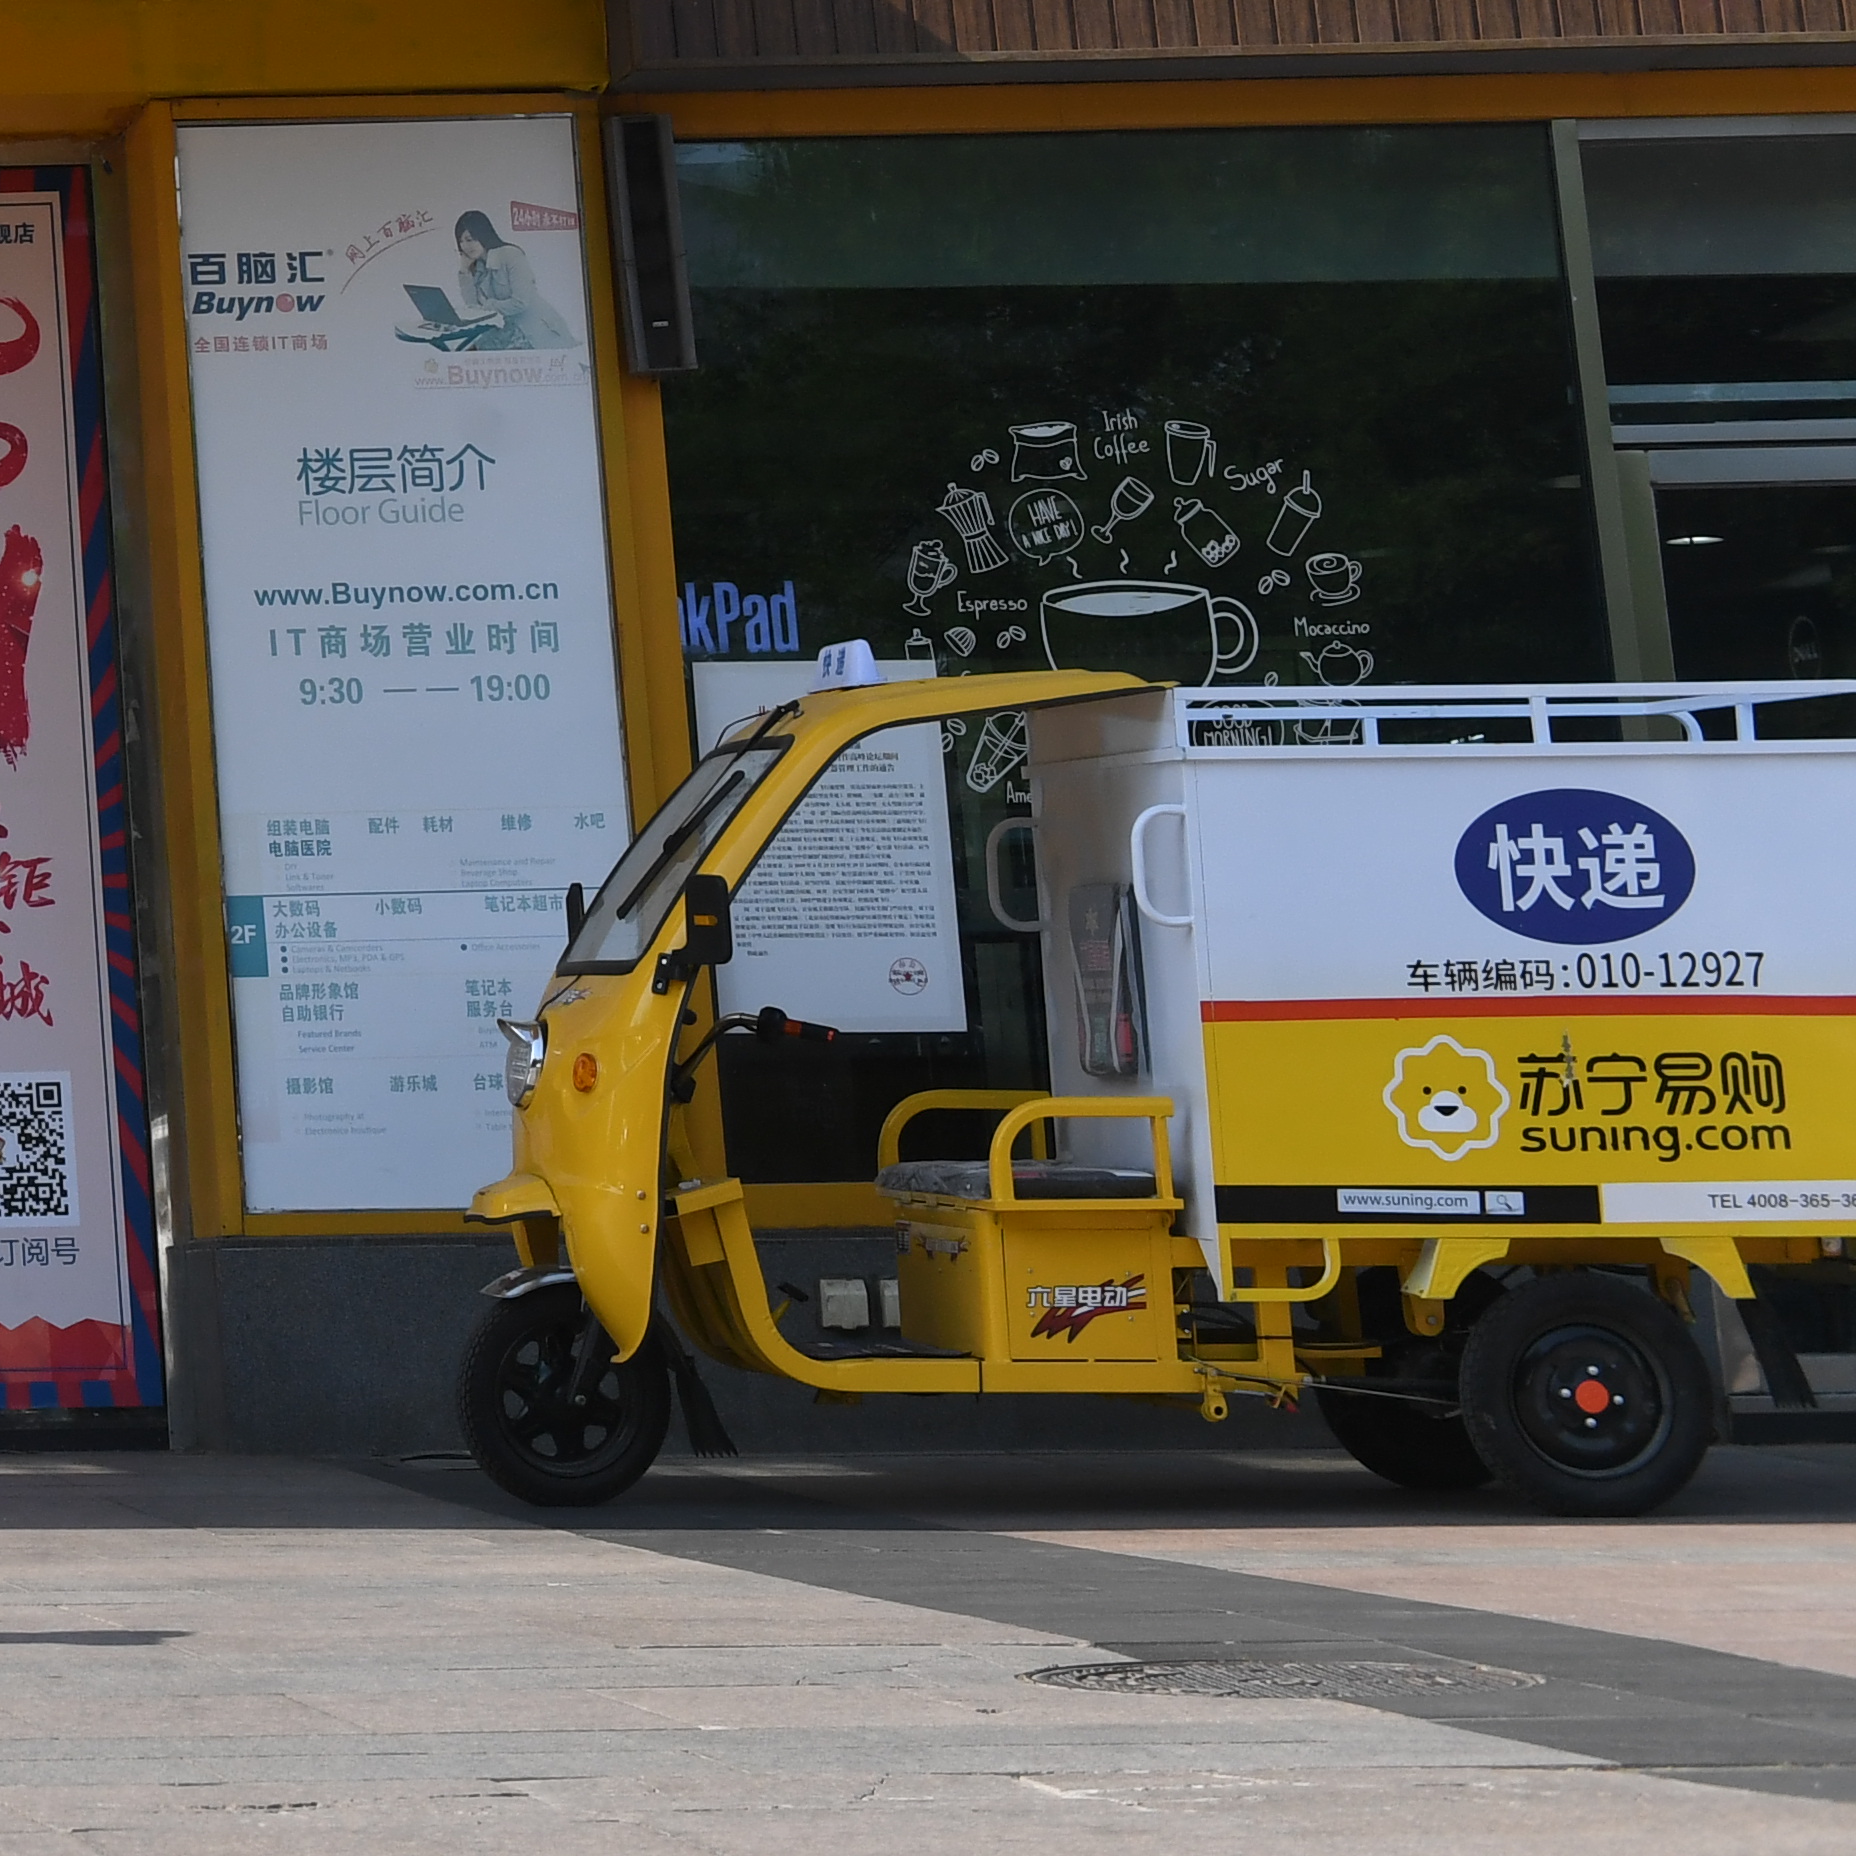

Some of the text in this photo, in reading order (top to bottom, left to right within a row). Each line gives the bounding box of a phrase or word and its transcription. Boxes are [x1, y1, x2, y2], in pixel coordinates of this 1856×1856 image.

[188, 250, 326, 286] 百脑汇
[191, 291, 326, 321] Buynow
[194, 334, 329, 354] 全国连锁IT商场
[1102, 409, 1138, 432] Irish
[1094, 436, 1150, 464] Coffee
[296, 443, 496, 496] 楼层简介
[1224, 458, 1284, 494] Sugar
[298, 496, 465, 527] Floor Guide
[1027, 495, 1063, 526] HAVE
[1021, 534, 1032, 548] A
[1033, 530, 1054, 547] NICE
[254, 580, 560, 611] www.Buynow.com.cn
[957, 590, 1028, 620] Espresso
[1294, 616, 1370, 637] Mocaccino
[269, 619, 561, 659] IT商场营业时间
[299, 673, 551, 705] 9:30 19:00
[267, 812, 606, 837] 组装电脑 配件 耗材 维修 水吧
[269, 839, 333, 858] 电脑医院
[1487, 822, 1666, 913] 快递
[272, 894, 563, 917] 大数码 小数码 笔记本超市
[231, 925, 256, 944] 2F
[274, 921, 338, 939] 办公设备
[280, 978, 512, 1001] 品牌形象馆 笔记本
[282, 1000, 513, 1022] 自助银行 服务台
[297, 1030, 333, 1038] Featured
[299, 1045, 326, 1053] Service
[287, 1073, 504, 1095] 摄影馆 游乐城 台球
[1517, 1050, 1788, 1116] 苏宁易购
[1519, 1124, 1792, 1162] suning.com
[1343, 1191, 1469, 1211] www.suning.com
[1708, 1194, 1742, 1208] TEL
[1027, 1286, 1127, 1309] 六星电动
